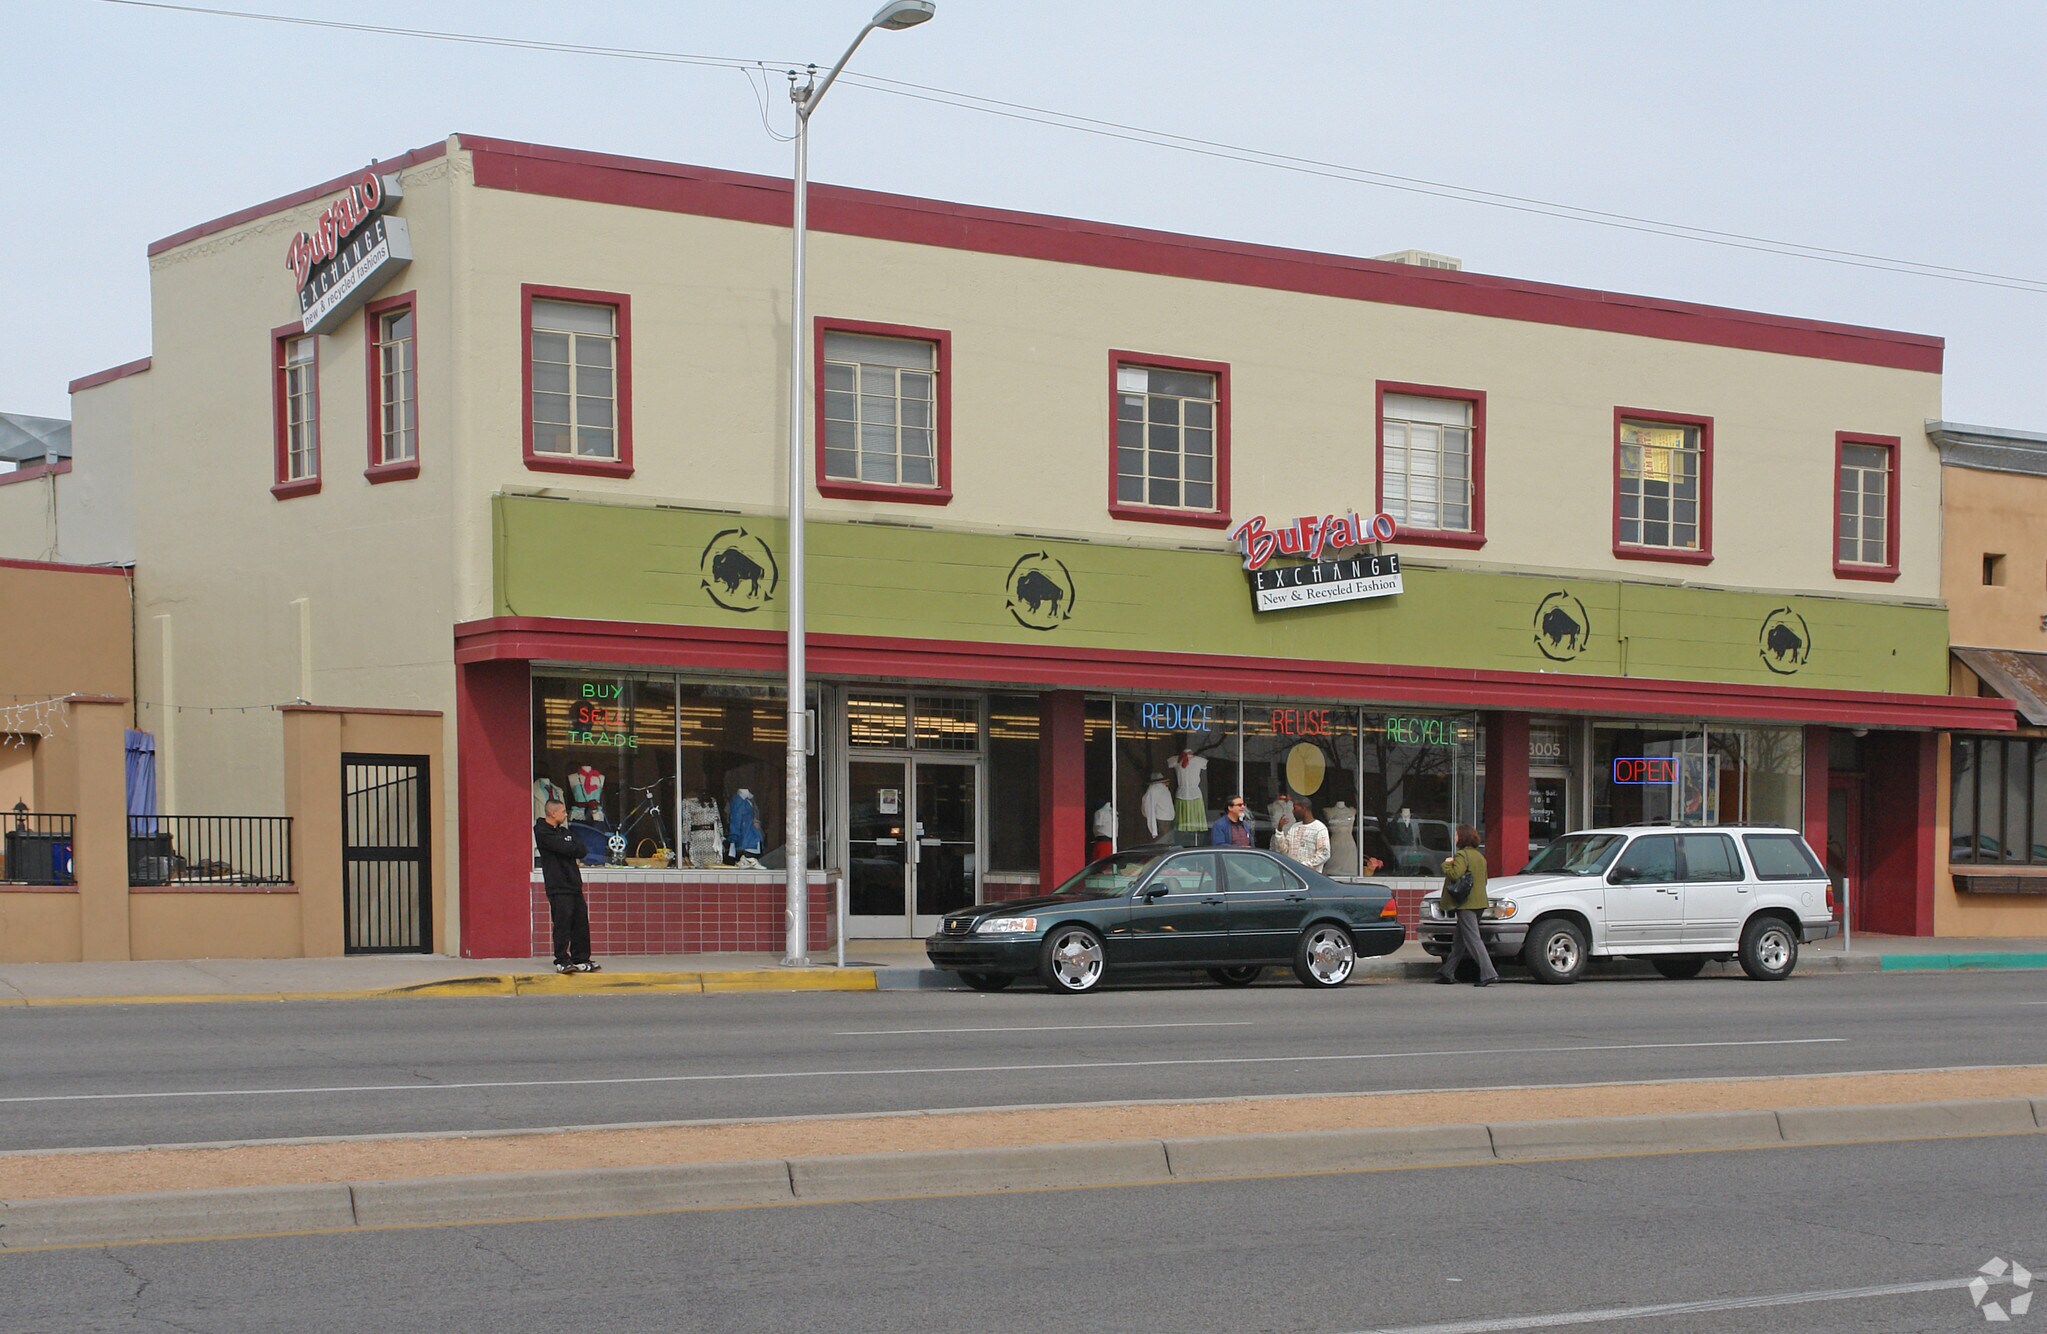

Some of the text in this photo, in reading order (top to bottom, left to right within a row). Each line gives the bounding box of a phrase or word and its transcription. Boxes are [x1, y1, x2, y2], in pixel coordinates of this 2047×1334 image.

[301, 220, 384, 312] EXCHANGE
[304, 247, 386, 327] new & recycled fashions
[1257, 556, 1398, 590] EXCHANGE
[1263, 579, 1396, 605] New & Recycled Fashion
[582, 683, 624, 699] BUY
[579, 706, 626, 726] SELL
[1142, 702, 1213, 732] REDUCE
[1272, 709, 1331, 737] REUSE
[568, 730, 639, 749] TRADE
[1387, 717, 1459, 746] RECYCLE
[1616, 759, 1678, 782] OPEN
